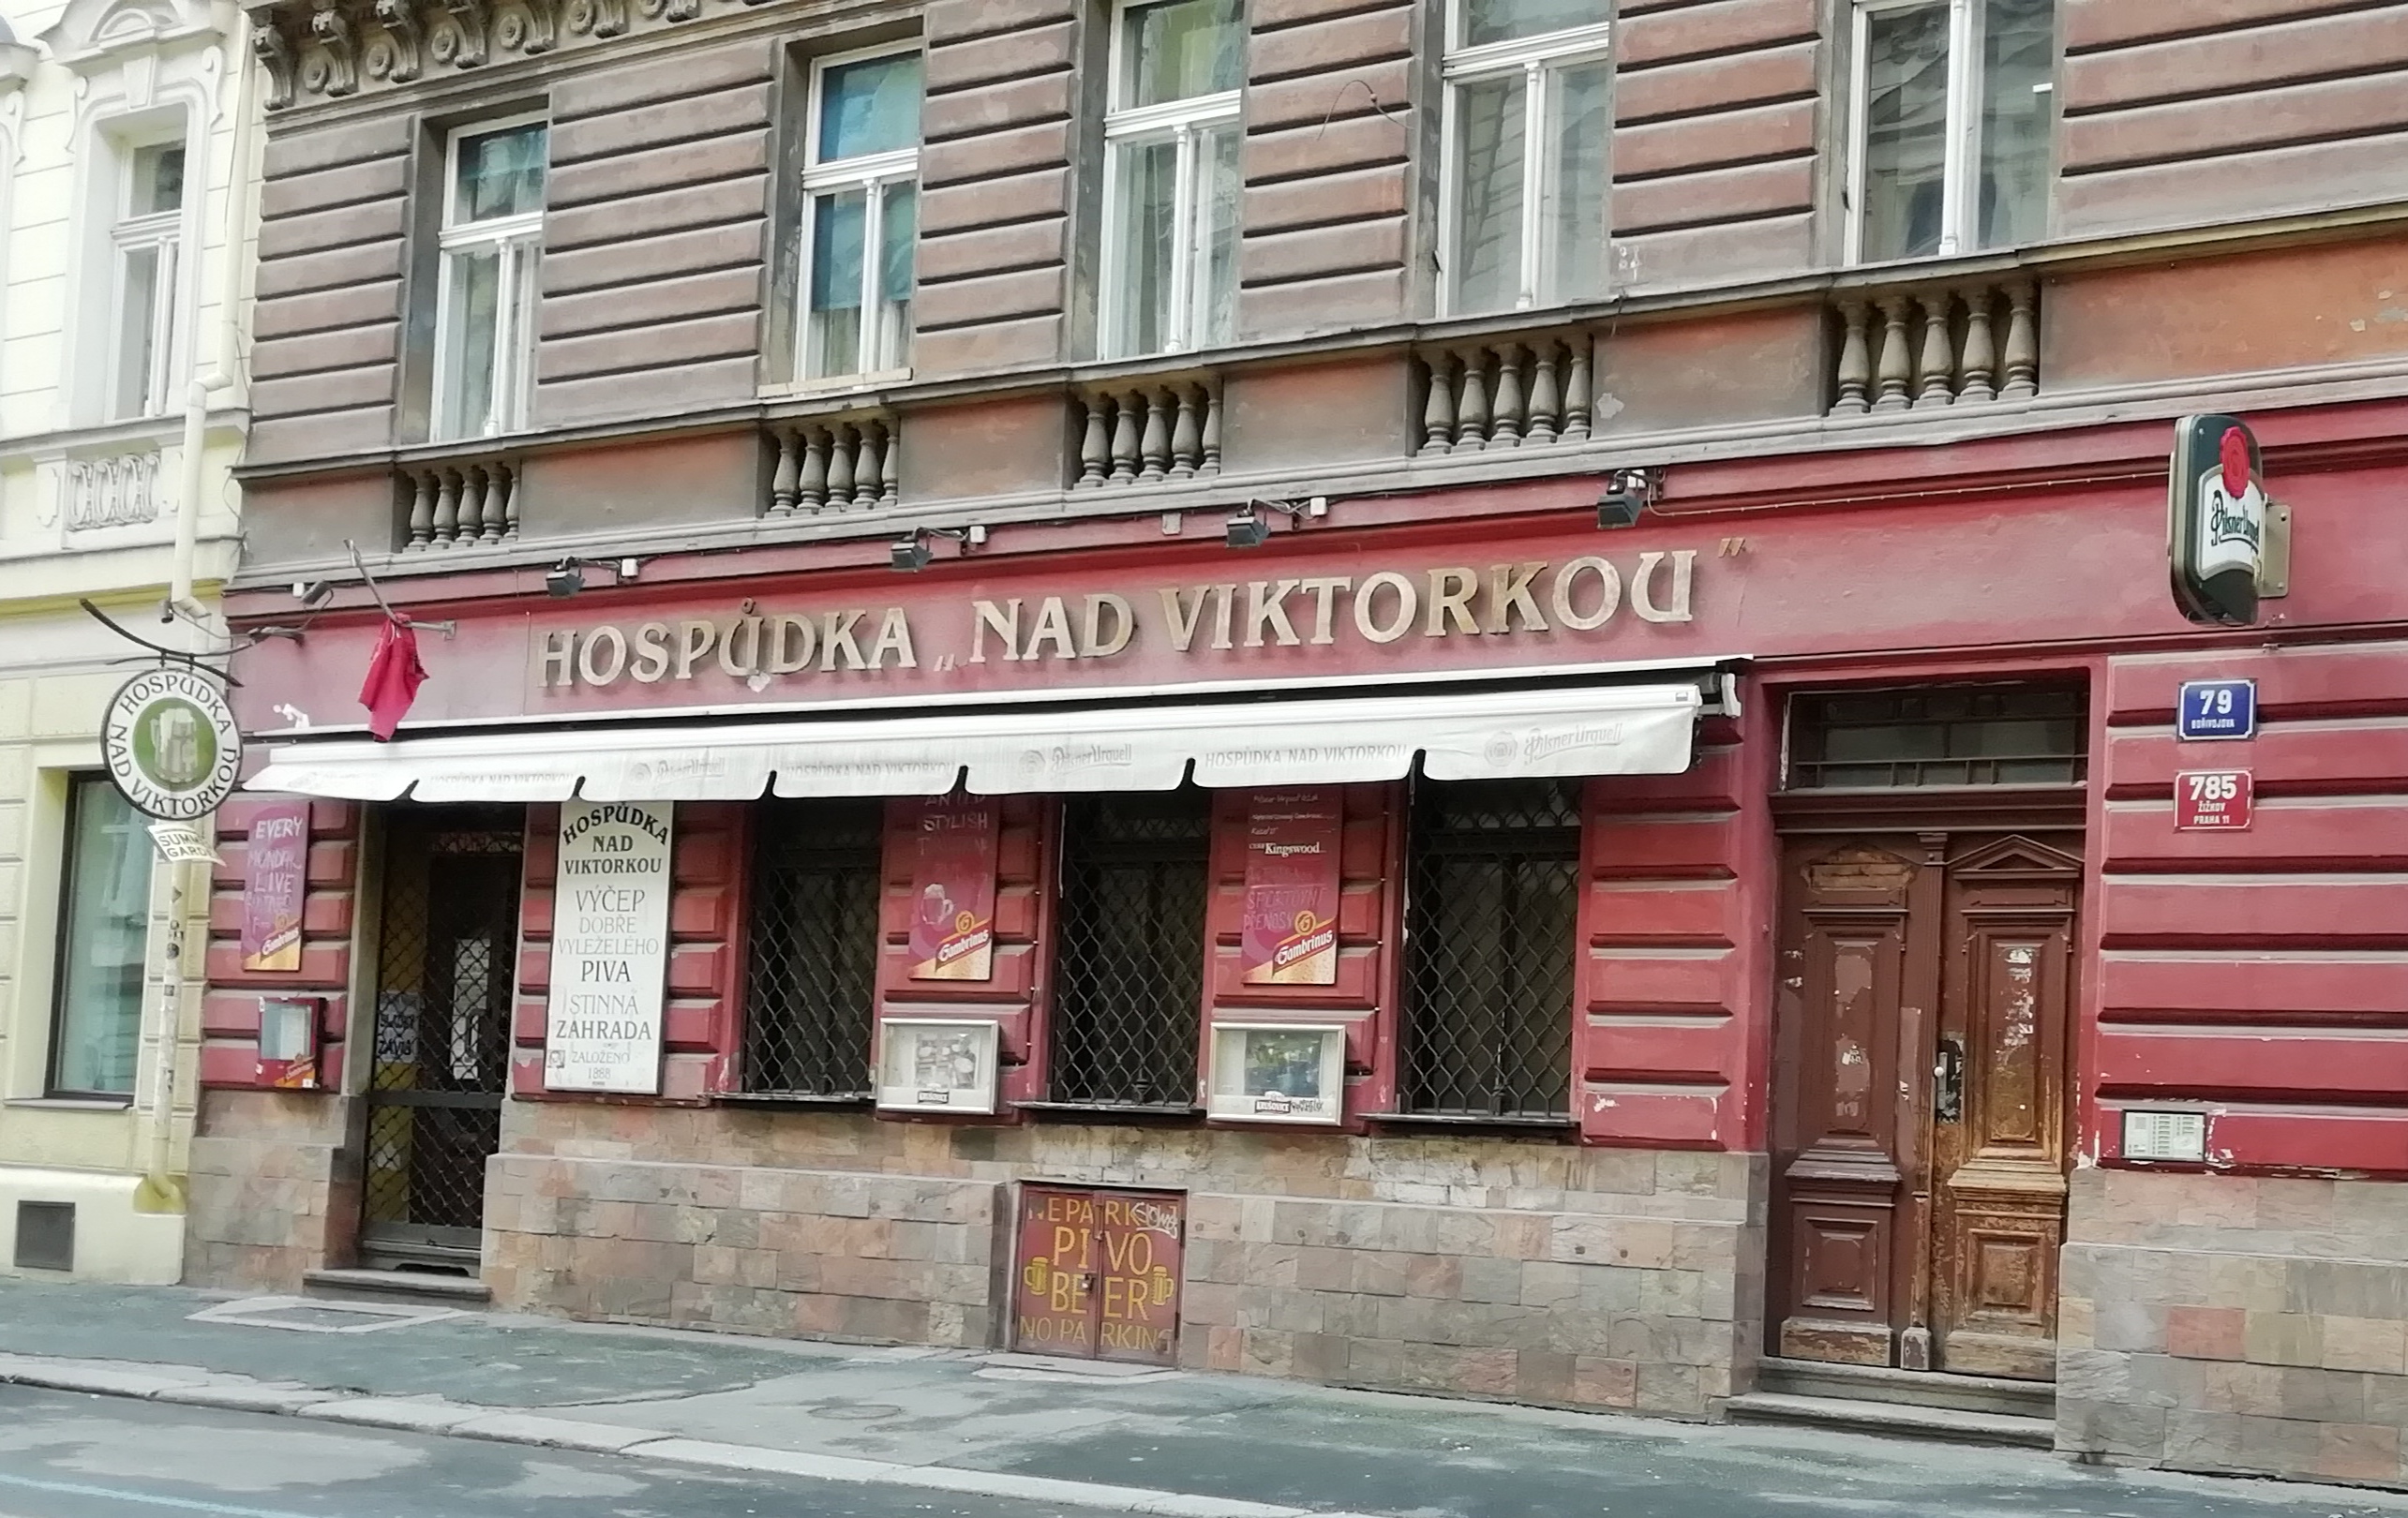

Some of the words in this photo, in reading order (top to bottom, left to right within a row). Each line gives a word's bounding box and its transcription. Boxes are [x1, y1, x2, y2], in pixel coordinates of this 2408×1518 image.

[2210, 489, 2244, 546] Pilsner
[536, 596, 918, 689] HOSPŮDKA
[2199, 689, 2233, 715] 79
[1091, 743, 1132, 764] Urquell
[1205, 746, 1281, 767] HOSPŮDKA
[1288, 747, 1318, 764] NAD
[1324, 744, 1407, 762] VIKTORKOU
[1523, 727, 1575, 766] Pilsner
[1576, 722, 1623, 748] Urquell
[108, 723, 132, 777] NAD
[130, 747, 237, 815] VIKTORKOU
[855, 762, 882, 776] NAD
[2190, 775, 2237, 800] 785
[2198, 800, 2226, 812] ŽIŽKOV
[255, 816, 304, 841] EVERY
[562, 801, 668, 845] HOSPŮDKA
[922, 811, 988, 831] STYLISH
[2194, 815, 2221, 825] PRAHA
[591, 835, 634, 853] NAD
[1264, 841, 1321, 857] Kingswood
[564, 857, 662, 874] VIKTORKOU
[254, 871, 295, 893] LIVE
[576, 885, 646, 912] VÝČEP
[579, 915, 637, 934] DOBŘE
[559, 936, 660, 955] VYLEŽELÉHO
[938, 929, 989, 962] Gambrinus
[1276, 930, 1334, 965] Gambrinus
[581, 960, 632, 982] PIVA
[570, 989, 639, 1015] STINNÁ
[556, 1019, 652, 1040] ZAHRADA
[1053, 1226, 1152, 1275] PIVO
[1051, 1271, 1150, 1321] BEER
[1020, 1316, 1053, 1342] NO
[1060, 1318, 1173, 1354] PARKING
